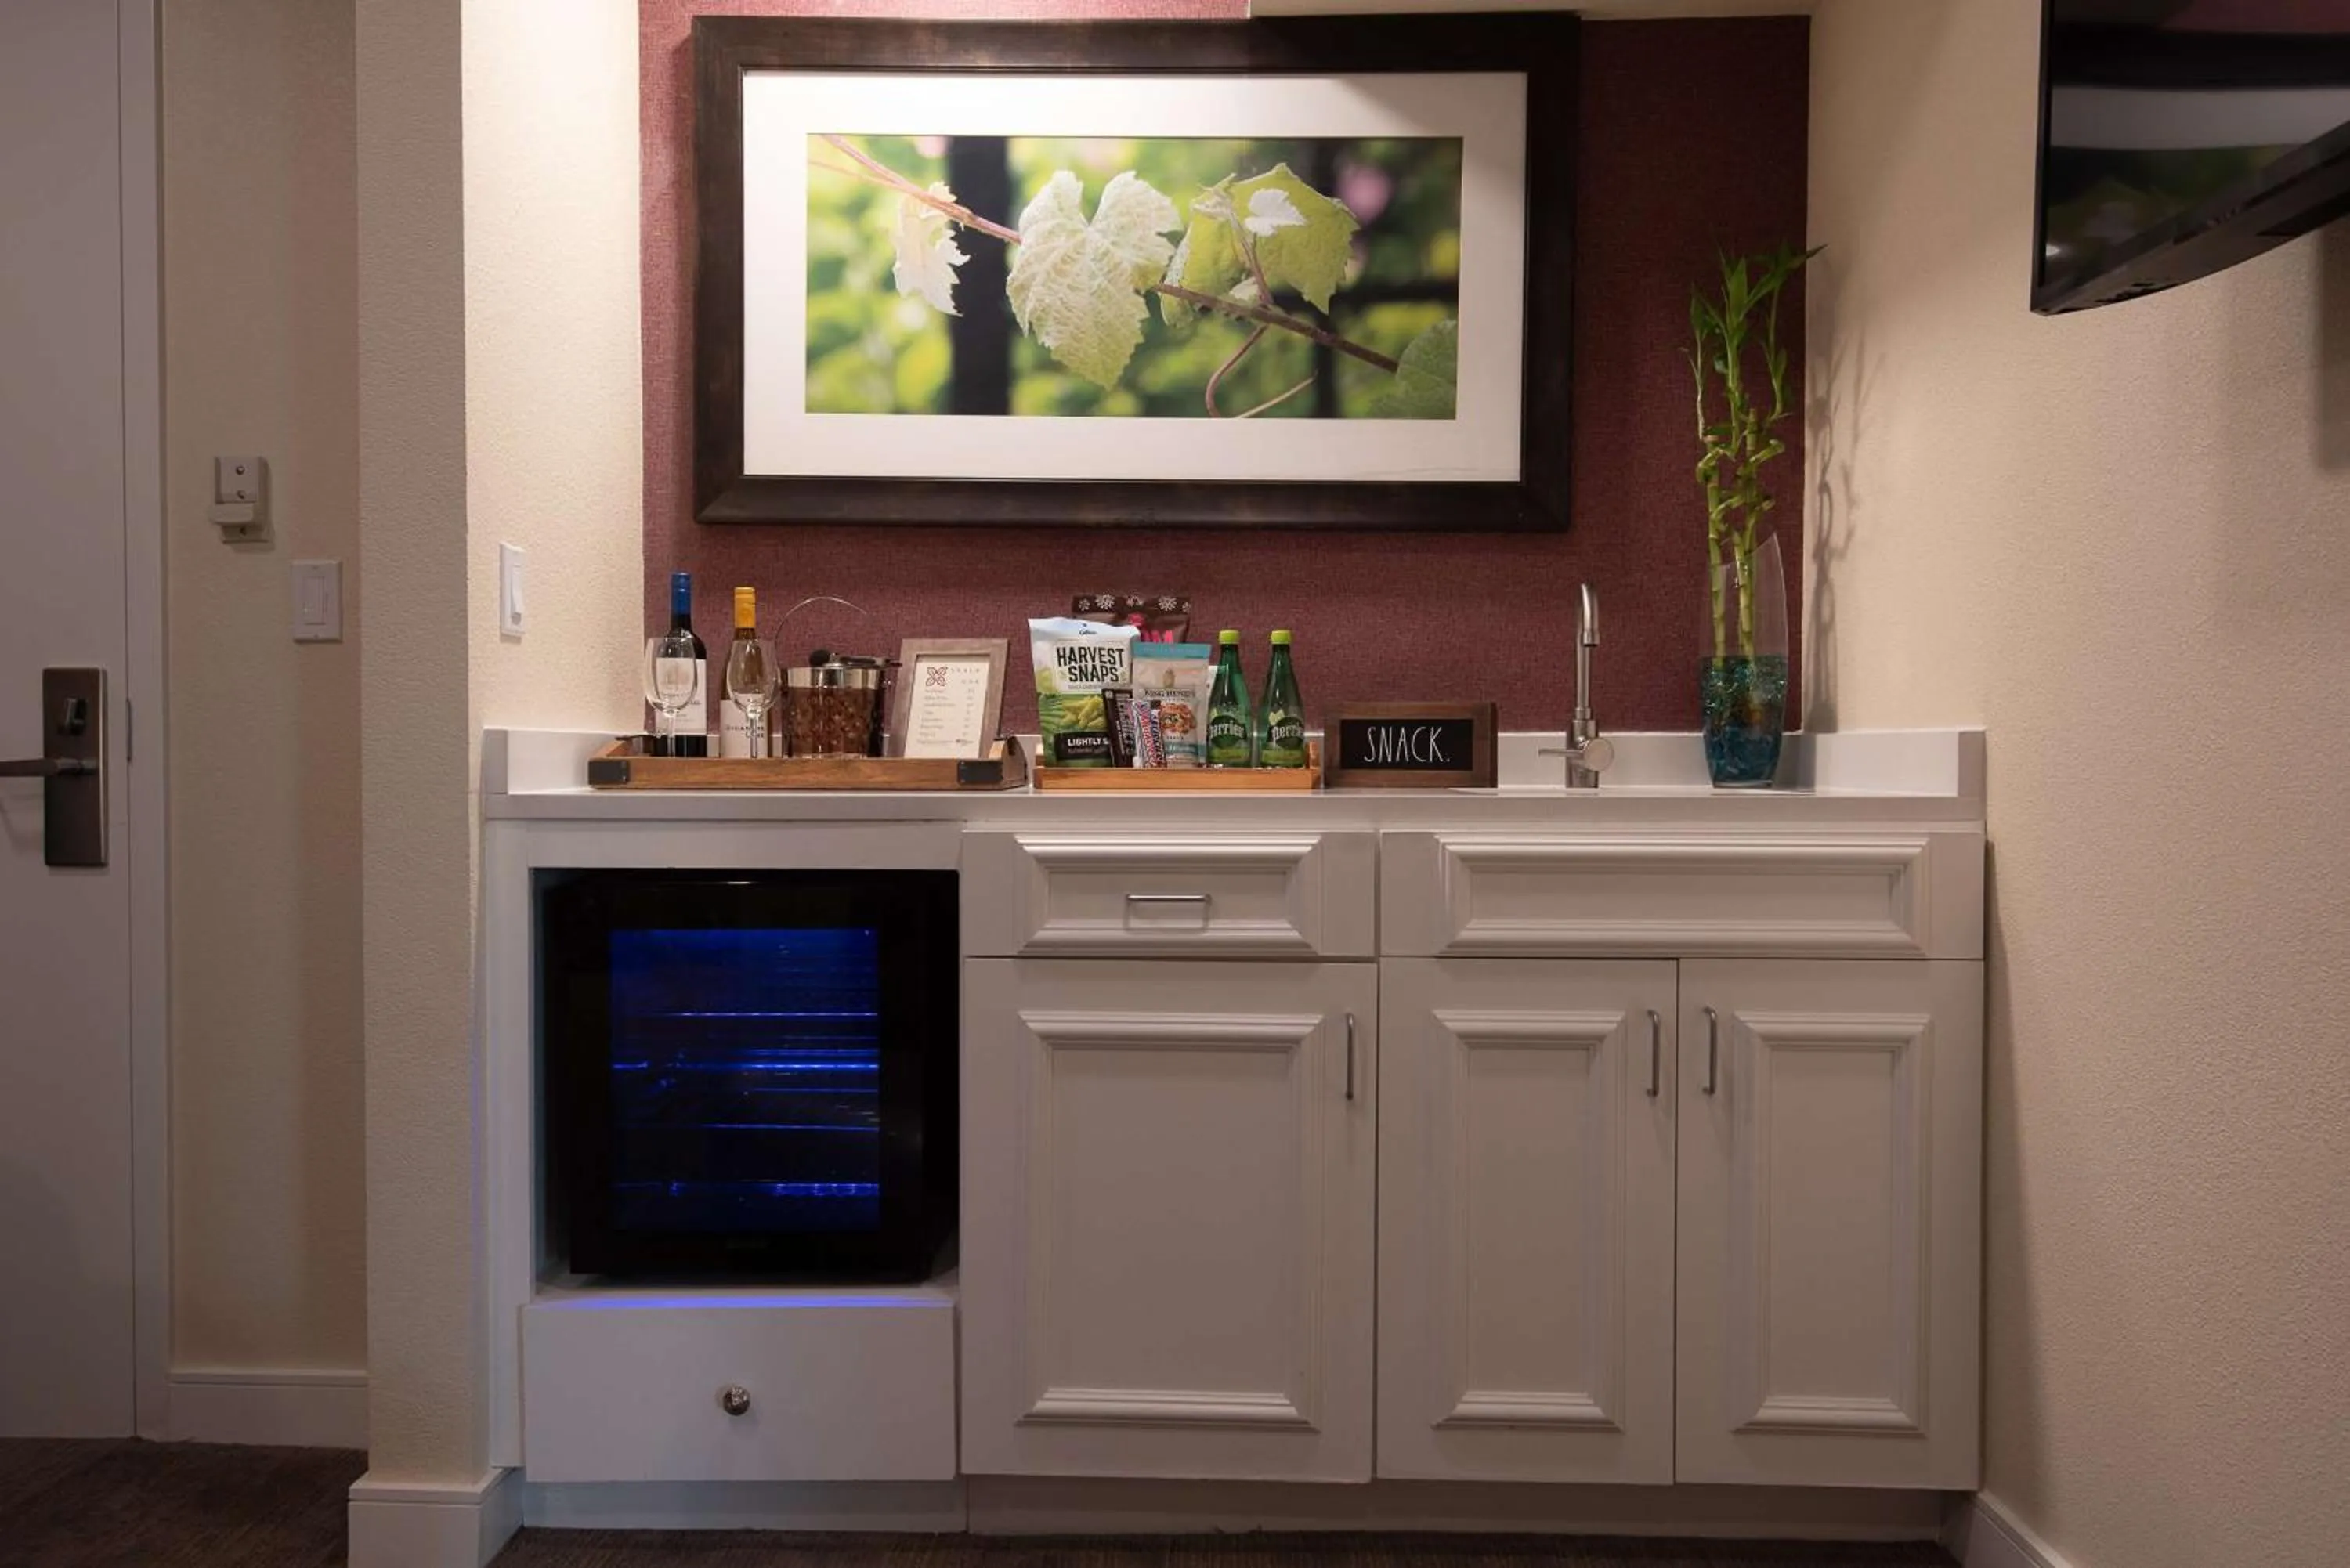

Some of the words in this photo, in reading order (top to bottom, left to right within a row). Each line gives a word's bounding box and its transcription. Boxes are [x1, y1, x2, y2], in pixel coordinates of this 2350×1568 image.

[1056, 646, 1124, 667] HARVEST
[1068, 664, 1119, 682] SNAPS
[1068, 738, 1101, 746] LIGHTLY
